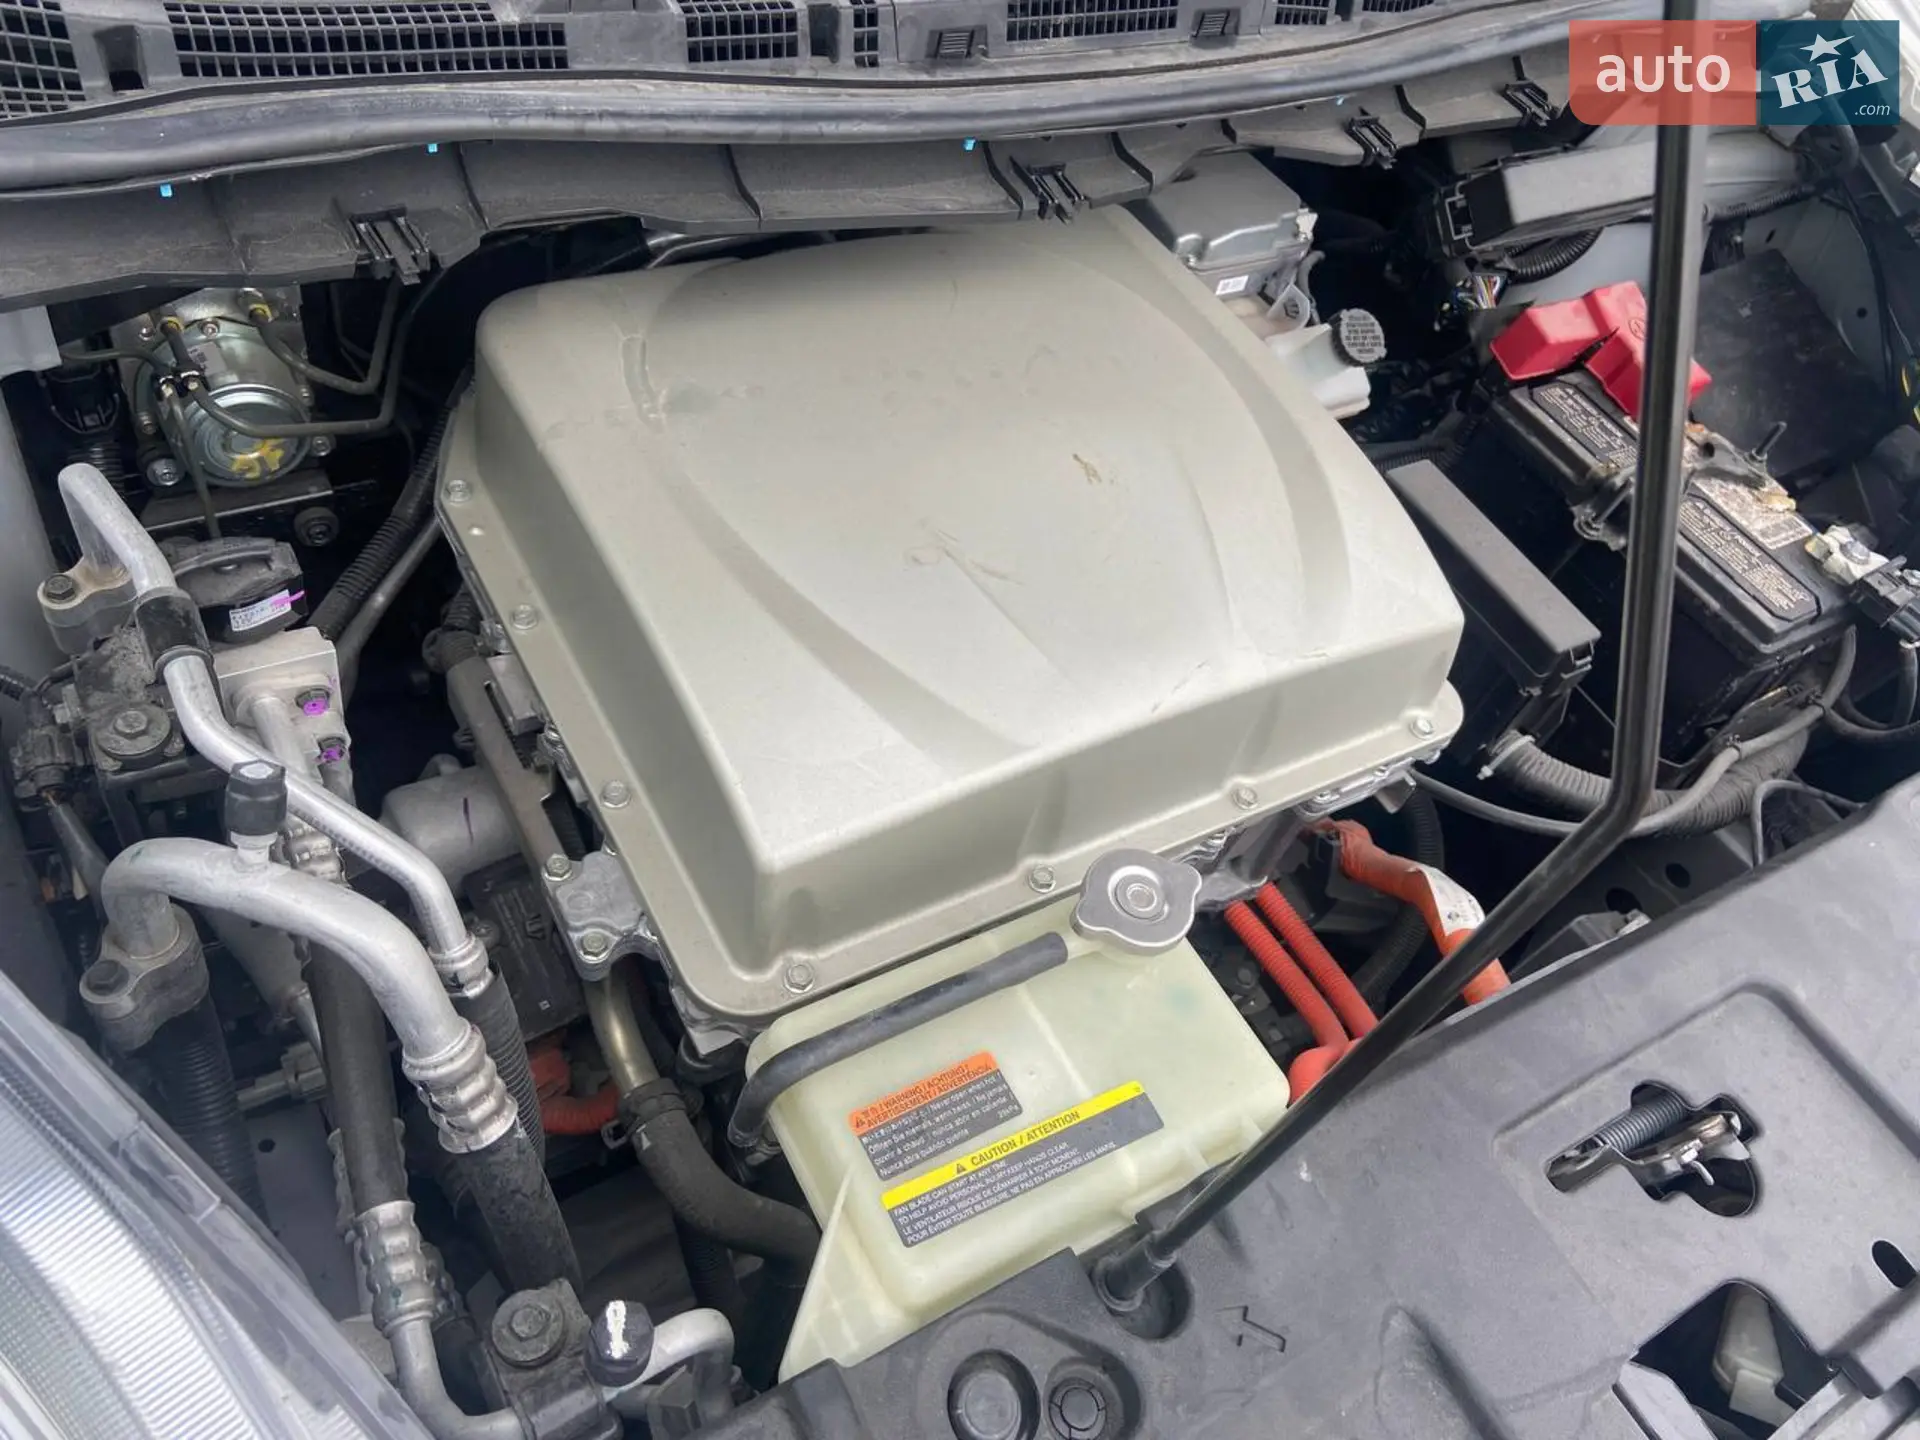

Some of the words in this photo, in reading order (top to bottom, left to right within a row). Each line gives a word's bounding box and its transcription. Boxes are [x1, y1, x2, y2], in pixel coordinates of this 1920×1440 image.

[883, 1086, 921, 1108] WARNING
[926, 1066, 965, 1088] ACHTUNG
[970, 1139, 1016, 1166] CAUTION
[1025, 1111, 1080, 1141] ATTENTION
[898, 1215, 909, 1225] TO
[908, 1207, 927, 1220] HELP
[927, 1197, 948, 1211] AVOID
[907, 1194, 930, 1210] BLADE
[931, 1187, 947, 1199] CAN
[907, 1229, 928, 1244] POUR
[951, 1207, 973, 1223] TOUTE
[1020, 1179, 1034, 1191] PAS
[902, 1225, 913, 1235] LE
[912, 1205, 956, 1231] VENTILATEUR
